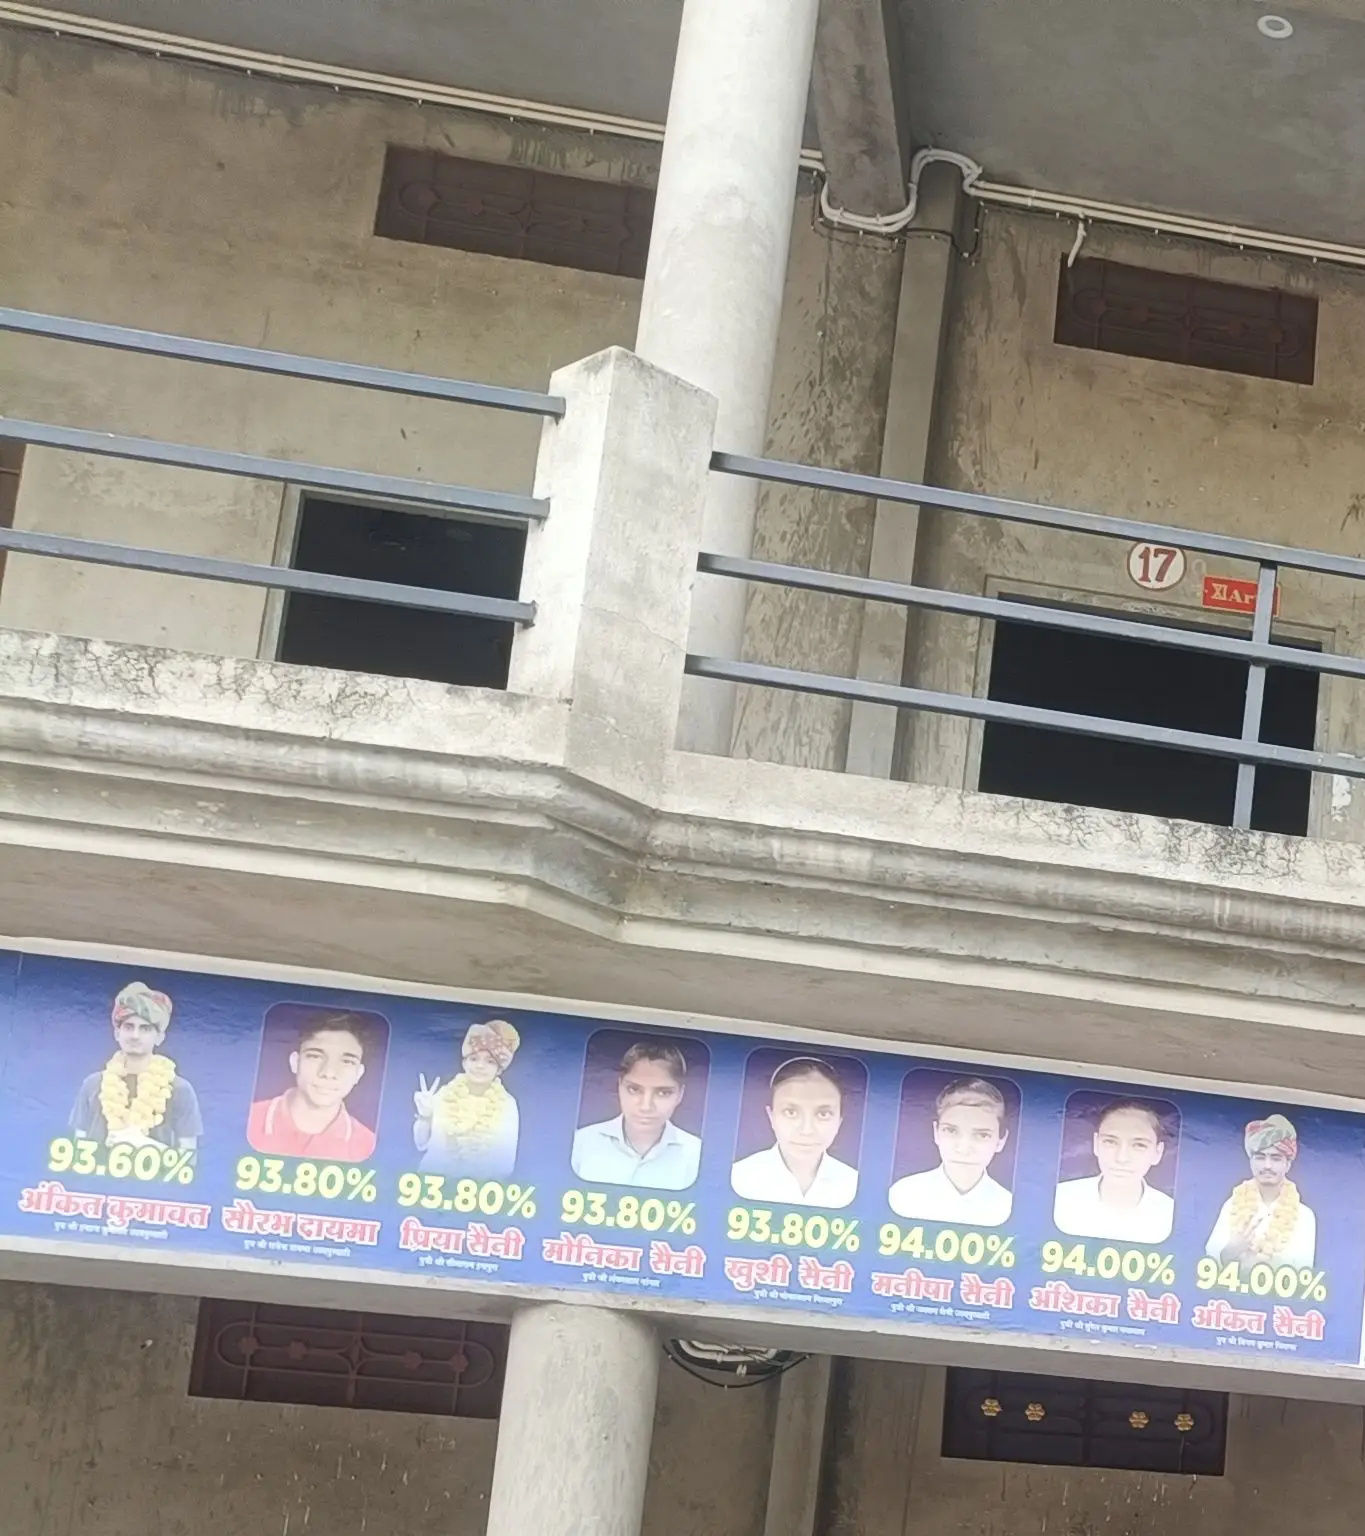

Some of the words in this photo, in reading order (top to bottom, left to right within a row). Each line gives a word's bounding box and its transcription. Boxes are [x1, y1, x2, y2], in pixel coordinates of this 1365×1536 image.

[1138, 546, 1177, 583] 17
[49, 1138, 194, 1184] 93.60%
[236, 1156, 377, 1202] 93.80%
[18, 1182, 104, 1218] अंकित
[106, 1196, 212, 1230] कुमावत
[398, 1173, 537, 1218] 93.80%
[561, 1190, 696, 1234] 93.80%
[221, 1199, 295, 1238] सौरभ
[297, 1213, 381, 1246] दायमा
[399, 1217, 465, 1253] प्रिया
[467, 1222, 524, 1260] सैनी
[727, 1207, 861, 1252] 93.80%
[542, 1233, 643, 1271] मोनिका
[649, 1238, 706, 1277] सैनी
[878, 1222, 1015, 1268] 94.00%
[1041, 1240, 1175, 1285] 94.00%
[724, 1254, 792, 1292] खुशी
[798, 1256, 854, 1292] सैनी
[871, 1269, 954, 1302] मनीषा
[959, 1273, 1015, 1309] सैनी
[1196, 1258, 1327, 1302] 94.00%
[1029, 1281, 1120, 1317] अंशिका
[1126, 1289, 1181, 1324] सैनी
[1191, 1299, 1266, 1334] अंकित
[1272, 1305, 1326, 1341] सैनी
